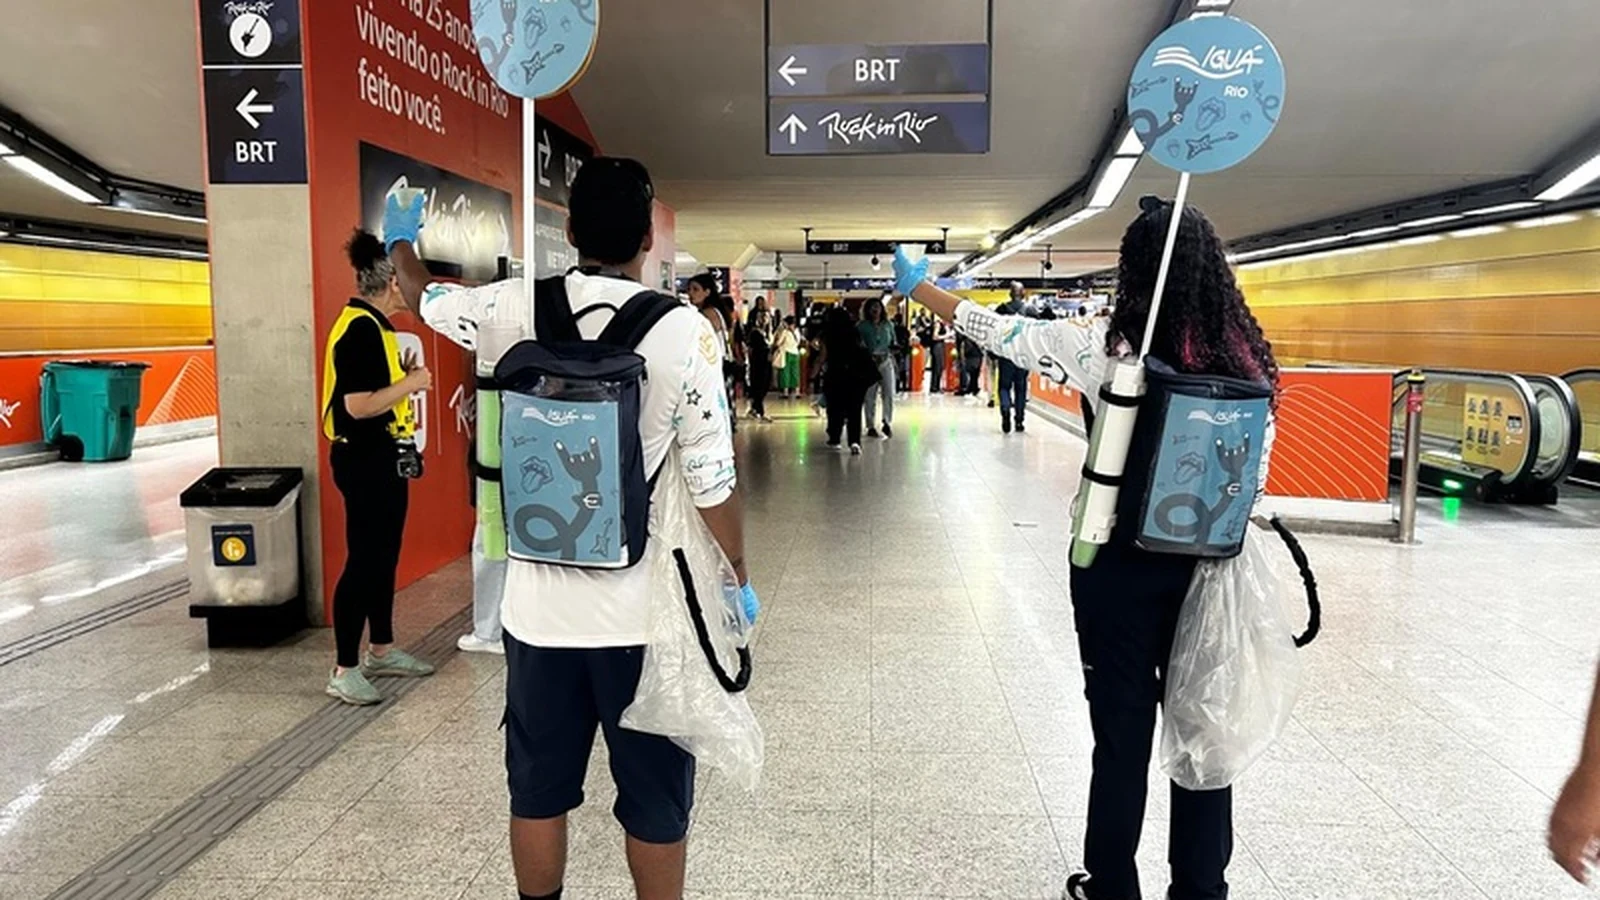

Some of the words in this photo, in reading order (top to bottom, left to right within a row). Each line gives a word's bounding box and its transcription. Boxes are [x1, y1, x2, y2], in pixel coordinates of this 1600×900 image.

[426, 0, 443, 31] 25
[356, 1, 427, 74] vivendo
[430, 52, 440, 81] o
[443, 51, 476, 101] Rock
[477, 70, 489, 109] in
[1201, 45, 1264, 75] IGUÁ
[855, 59, 900, 82] BRT
[358, 57, 402, 116] feito
[404, 90, 446, 135] você.
[1223, 85, 1250, 98] RIO
[818, 111, 877, 144] Rock
[876, 117, 896, 135] in
[893, 111, 938, 143] Rio
[235, 141, 278, 164] BRT
